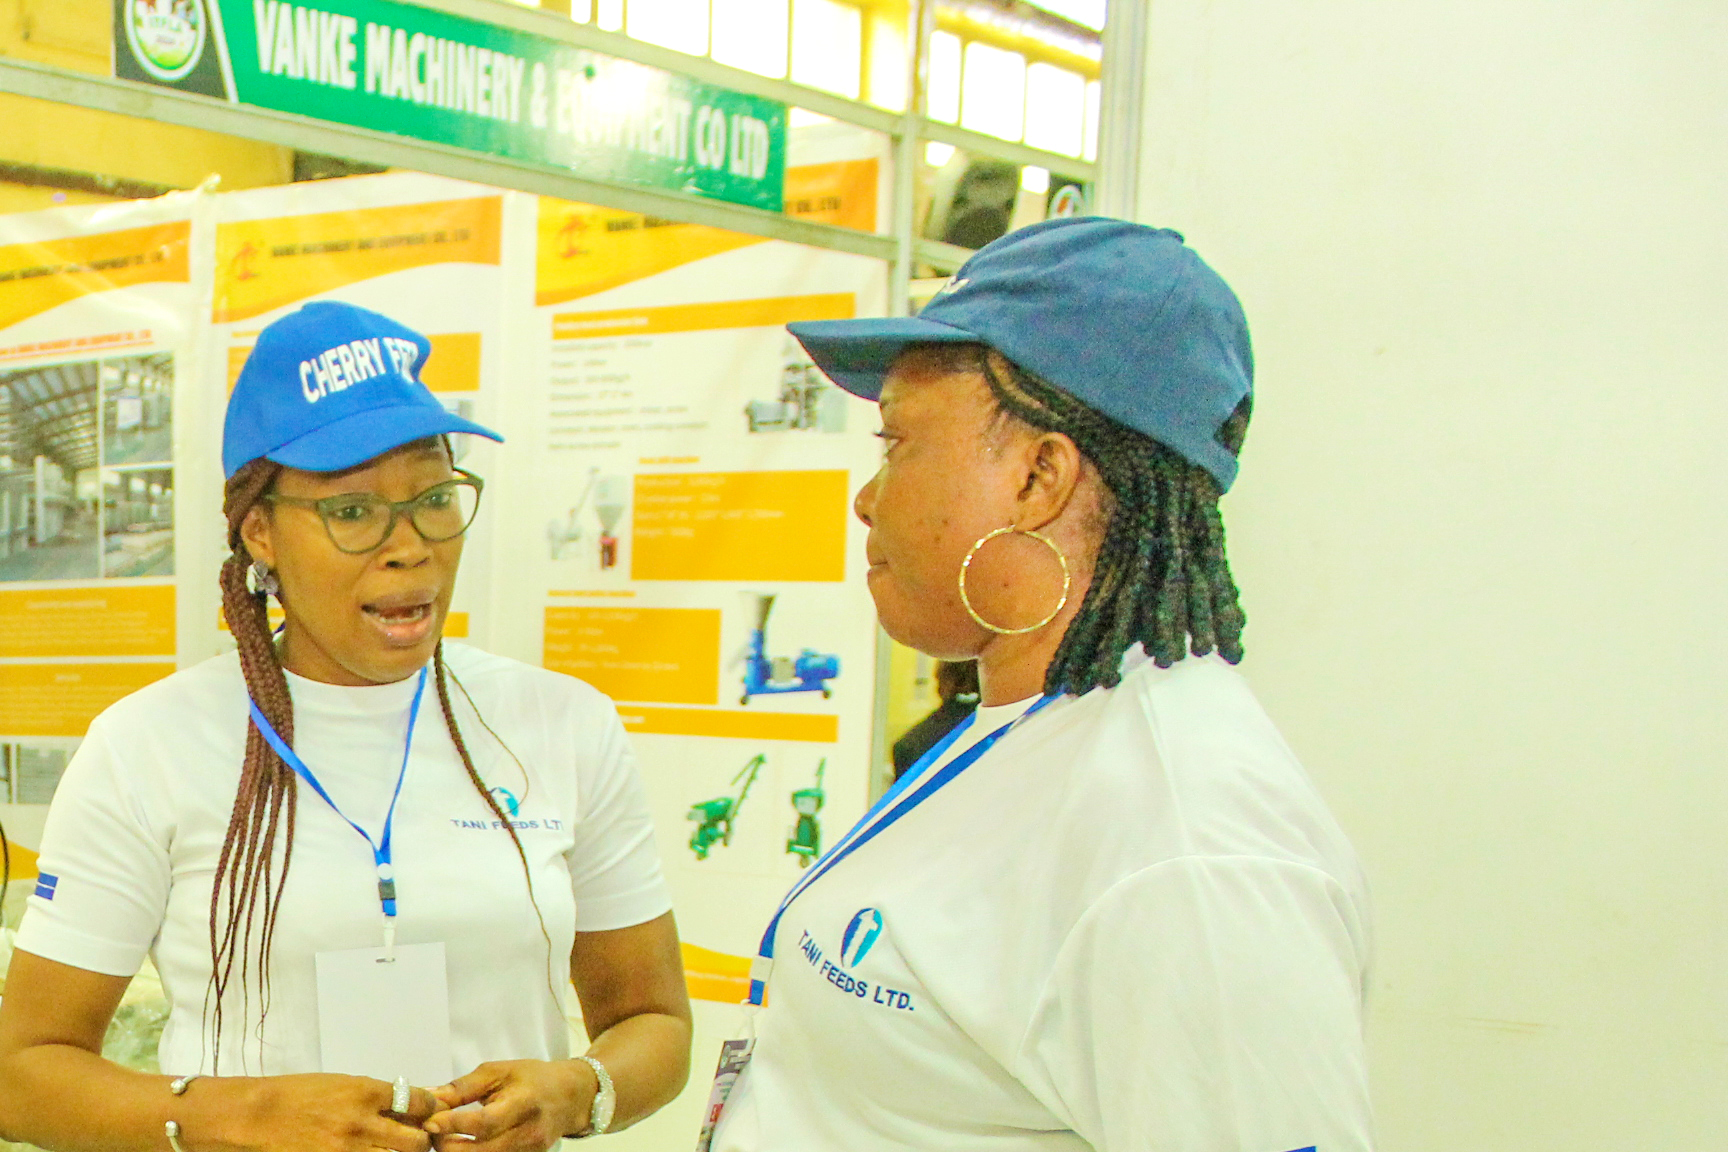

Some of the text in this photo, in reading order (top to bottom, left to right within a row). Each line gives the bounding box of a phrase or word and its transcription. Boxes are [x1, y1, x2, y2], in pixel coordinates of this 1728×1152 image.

[253, 0, 357, 90] VANKE
[365, 22, 525, 123] MACHINERY
[530, 62, 547, 128] &
[694, 104, 726, 170] CO
[728, 113, 770, 180] LTD
[299, 337, 387, 404] CHERRY
[450, 819, 487, 830] TANI
[798, 929, 915, 1011] TANI FEEDS LTD.
